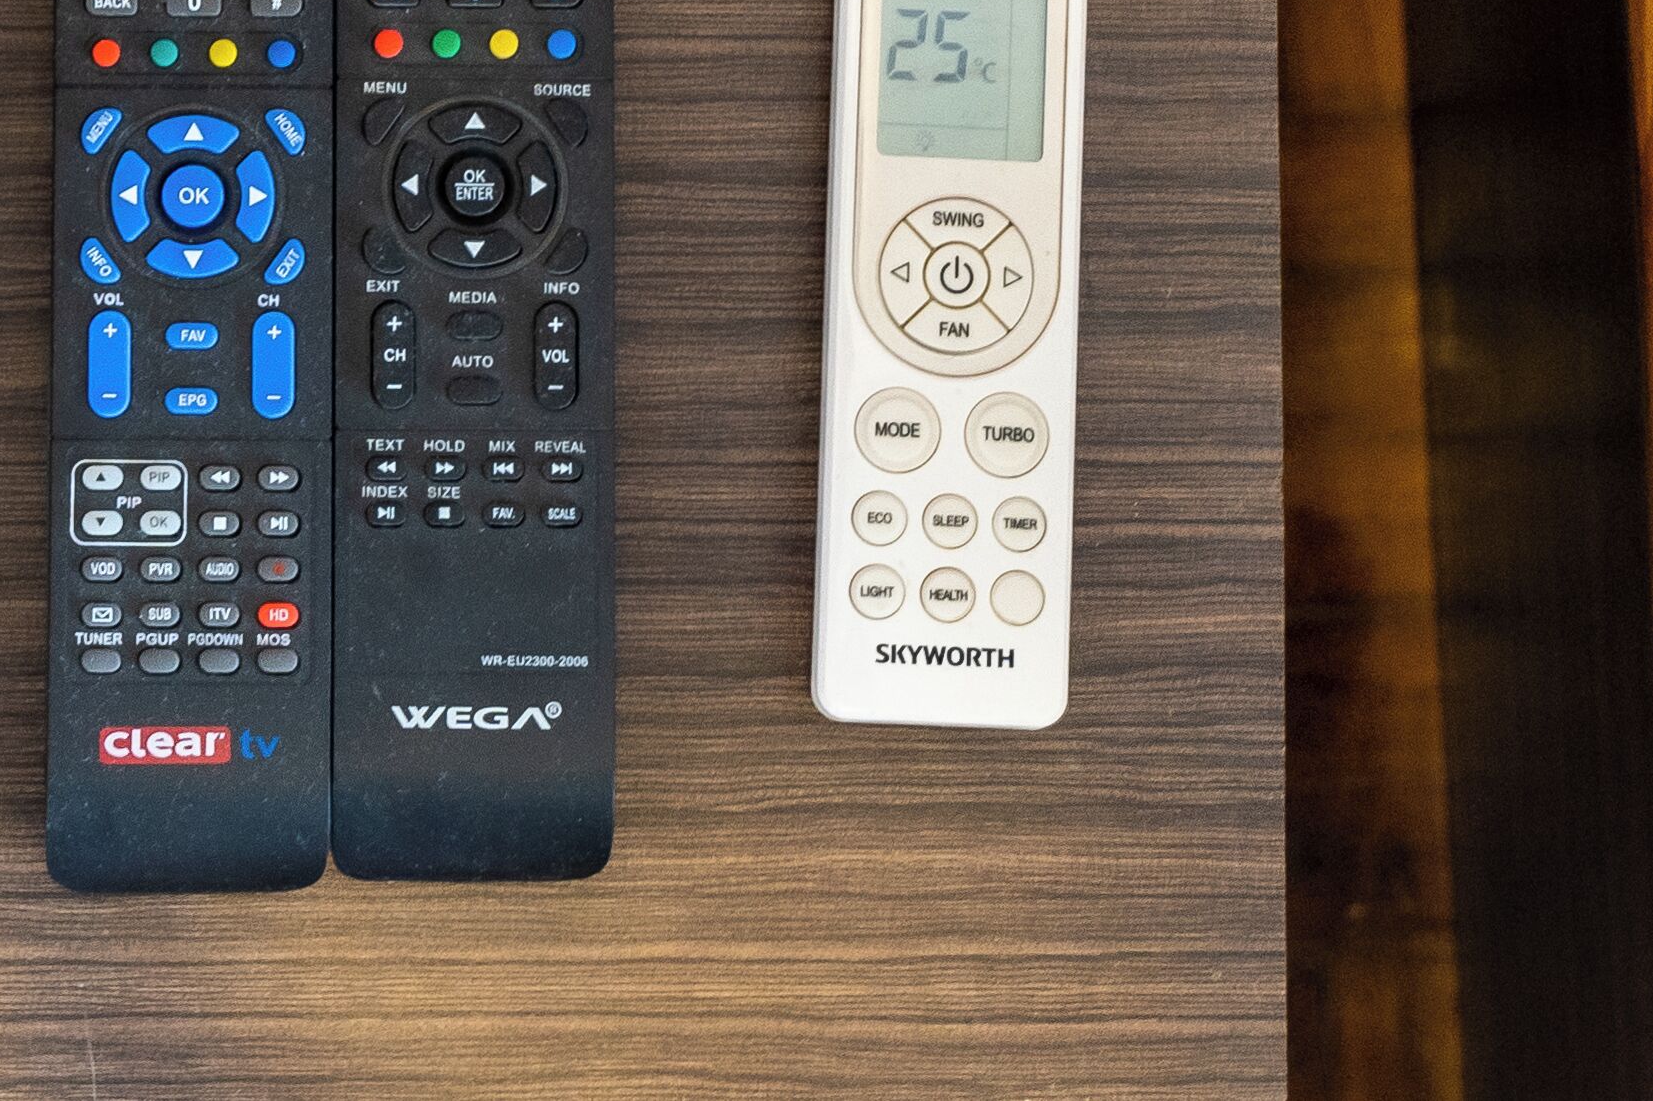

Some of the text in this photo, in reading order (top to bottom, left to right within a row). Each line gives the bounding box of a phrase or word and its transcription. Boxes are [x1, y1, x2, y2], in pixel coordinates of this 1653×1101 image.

[364, 82, 406, 93] MENU
[534, 84, 590, 96] SOURCE
[86, 112, 114, 145] MENU
[275, 113, 301, 146] HOME
[463, 169, 487, 183] OK
[179, 188, 208, 204] OK
[455, 186, 494, 201] ENTER
[934, 212, 984, 227] SWING
[85, 247, 113, 278] INFO
[276, 250, 301, 278] EXIT
[367, 280, 399, 292] EXIT
[544, 282, 579, 294] INFO
[94, 293, 123, 305] VOL
[258, 294, 279, 306] CH
[449, 292, 496, 303] MEDIA
[181, 330, 205, 341] FAV
[940, 322, 969, 337] FAN
[384, 349, 406, 362] CH
[452, 356, 493, 368] AUTO
[543, 350, 569, 363] VOL
[179, 394, 206, 406] EPG
[876, 422, 1034, 442] MODE TURBO
[367, 439, 585, 453] TEXT HOLD MIX REVEAL
[149, 471, 169, 481] PIP
[362, 486, 459, 498] INDEX SIZE
[117, 497, 141, 508] PIP
[549, 508, 575, 519] SCALE
[150, 516, 167, 527] OK
[868, 512, 1037, 529] ECO SLEEP TIMER
[91, 562, 234, 575] VOD PVR AUDIO
[861, 586, 967, 600] LIGHT HEALTH
[149, 608, 288, 621] SUB ITV HD
[75, 632, 290, 646] TUNER PGUP PGDOWN MOS
[876, 644, 1014, 668] SKYWORTH
[104, 729, 281, 759] clear tv
